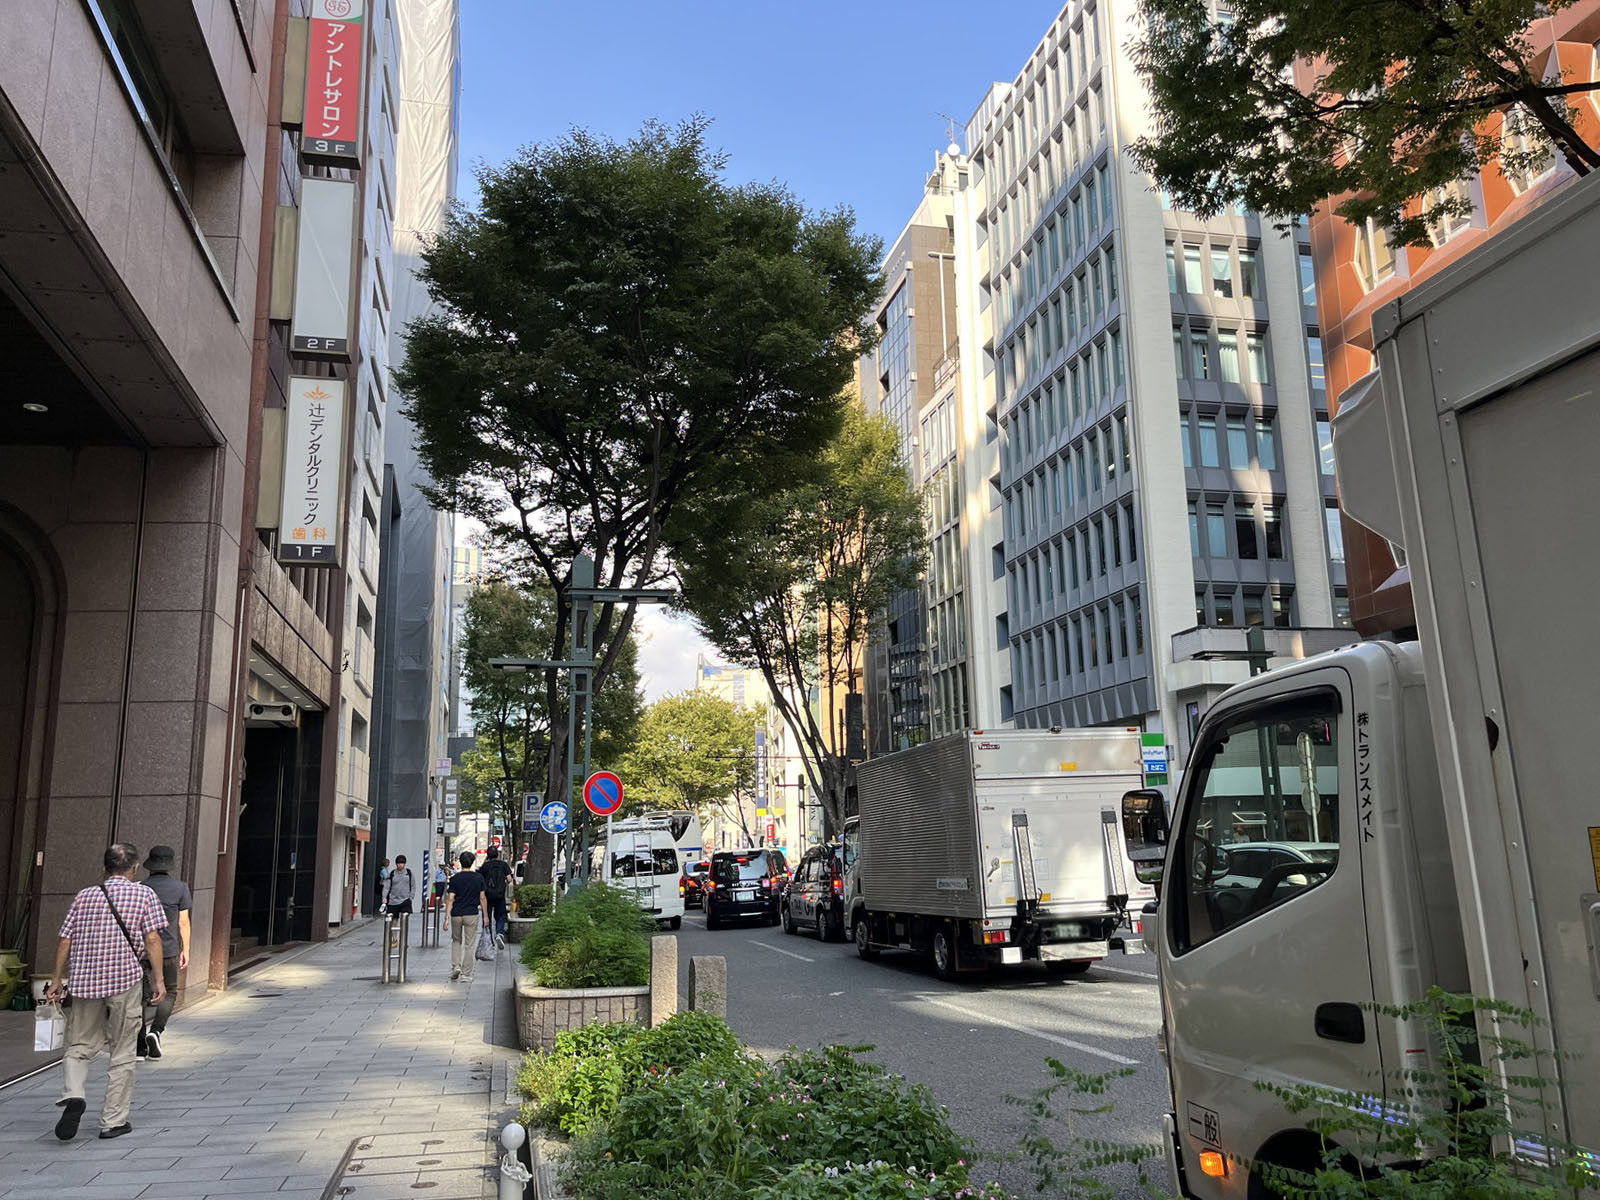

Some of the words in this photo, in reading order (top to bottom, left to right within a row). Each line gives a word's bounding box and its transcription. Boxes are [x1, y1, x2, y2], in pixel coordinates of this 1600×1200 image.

[322, 22, 346, 137] アントレサロン
[303, 402, 325, 525] 辻デンタルクリニック
[292, 527, 327, 541] 歯科
[526, 795, 539, 811] P
[1190, 1112, 1219, 1145] 一般
